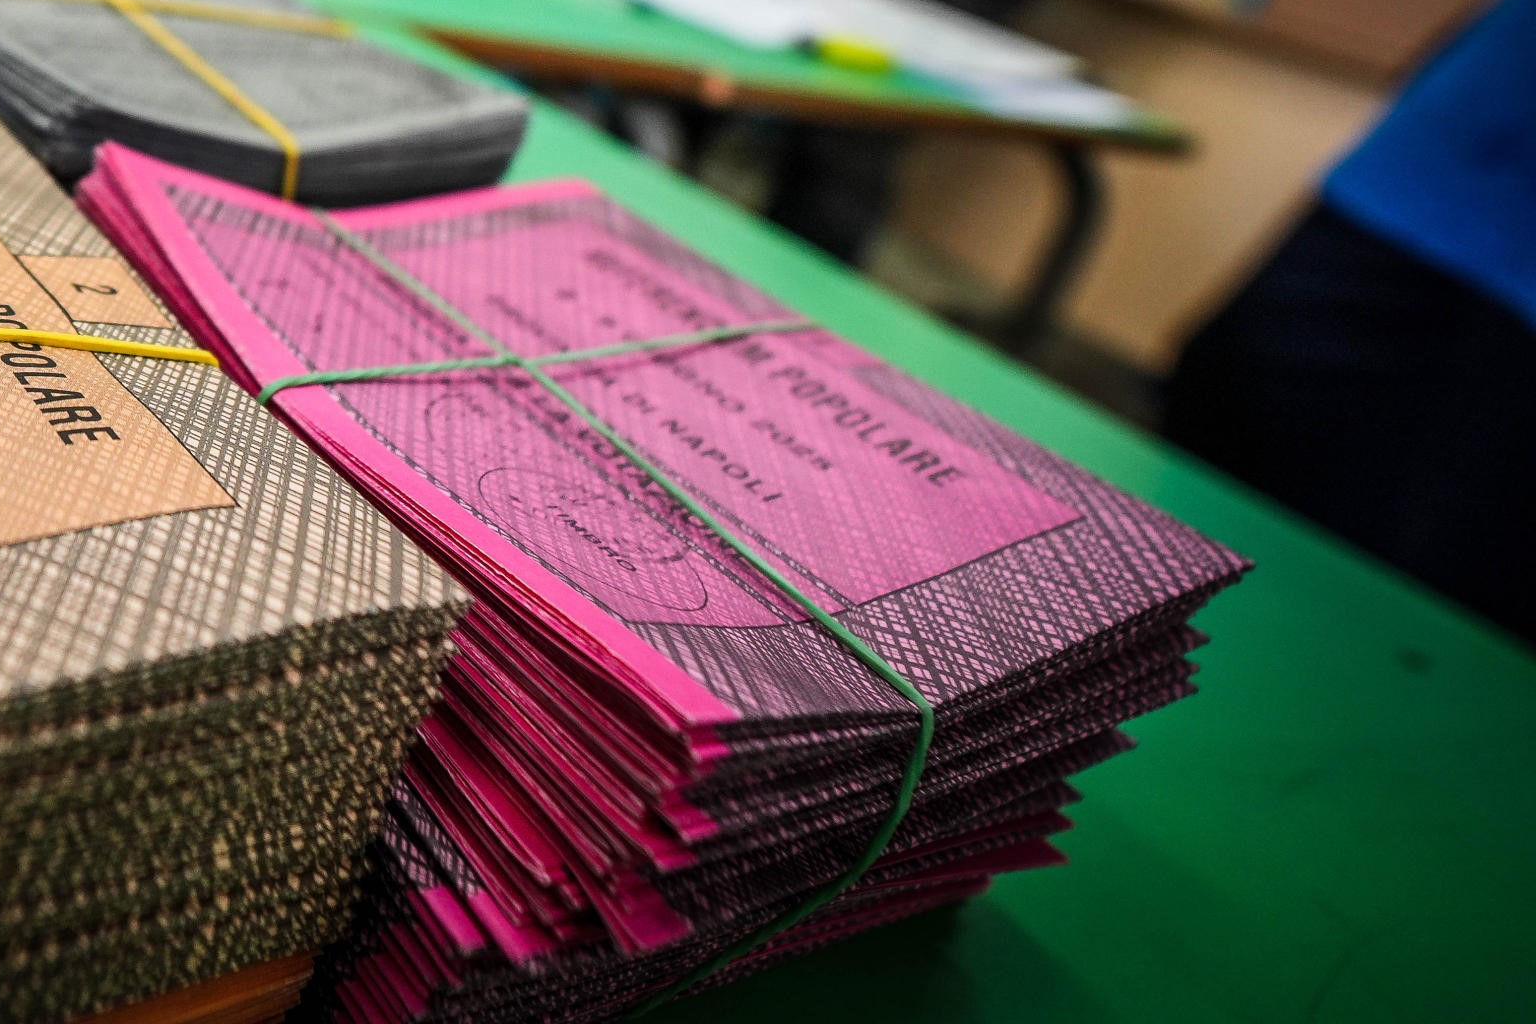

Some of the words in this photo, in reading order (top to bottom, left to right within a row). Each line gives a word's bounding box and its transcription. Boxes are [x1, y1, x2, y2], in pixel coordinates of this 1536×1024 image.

[71, 281, 119, 296] 2
[661, 419, 783, 503] NAPOLI
[768, 365, 966, 488] POPOLARE
